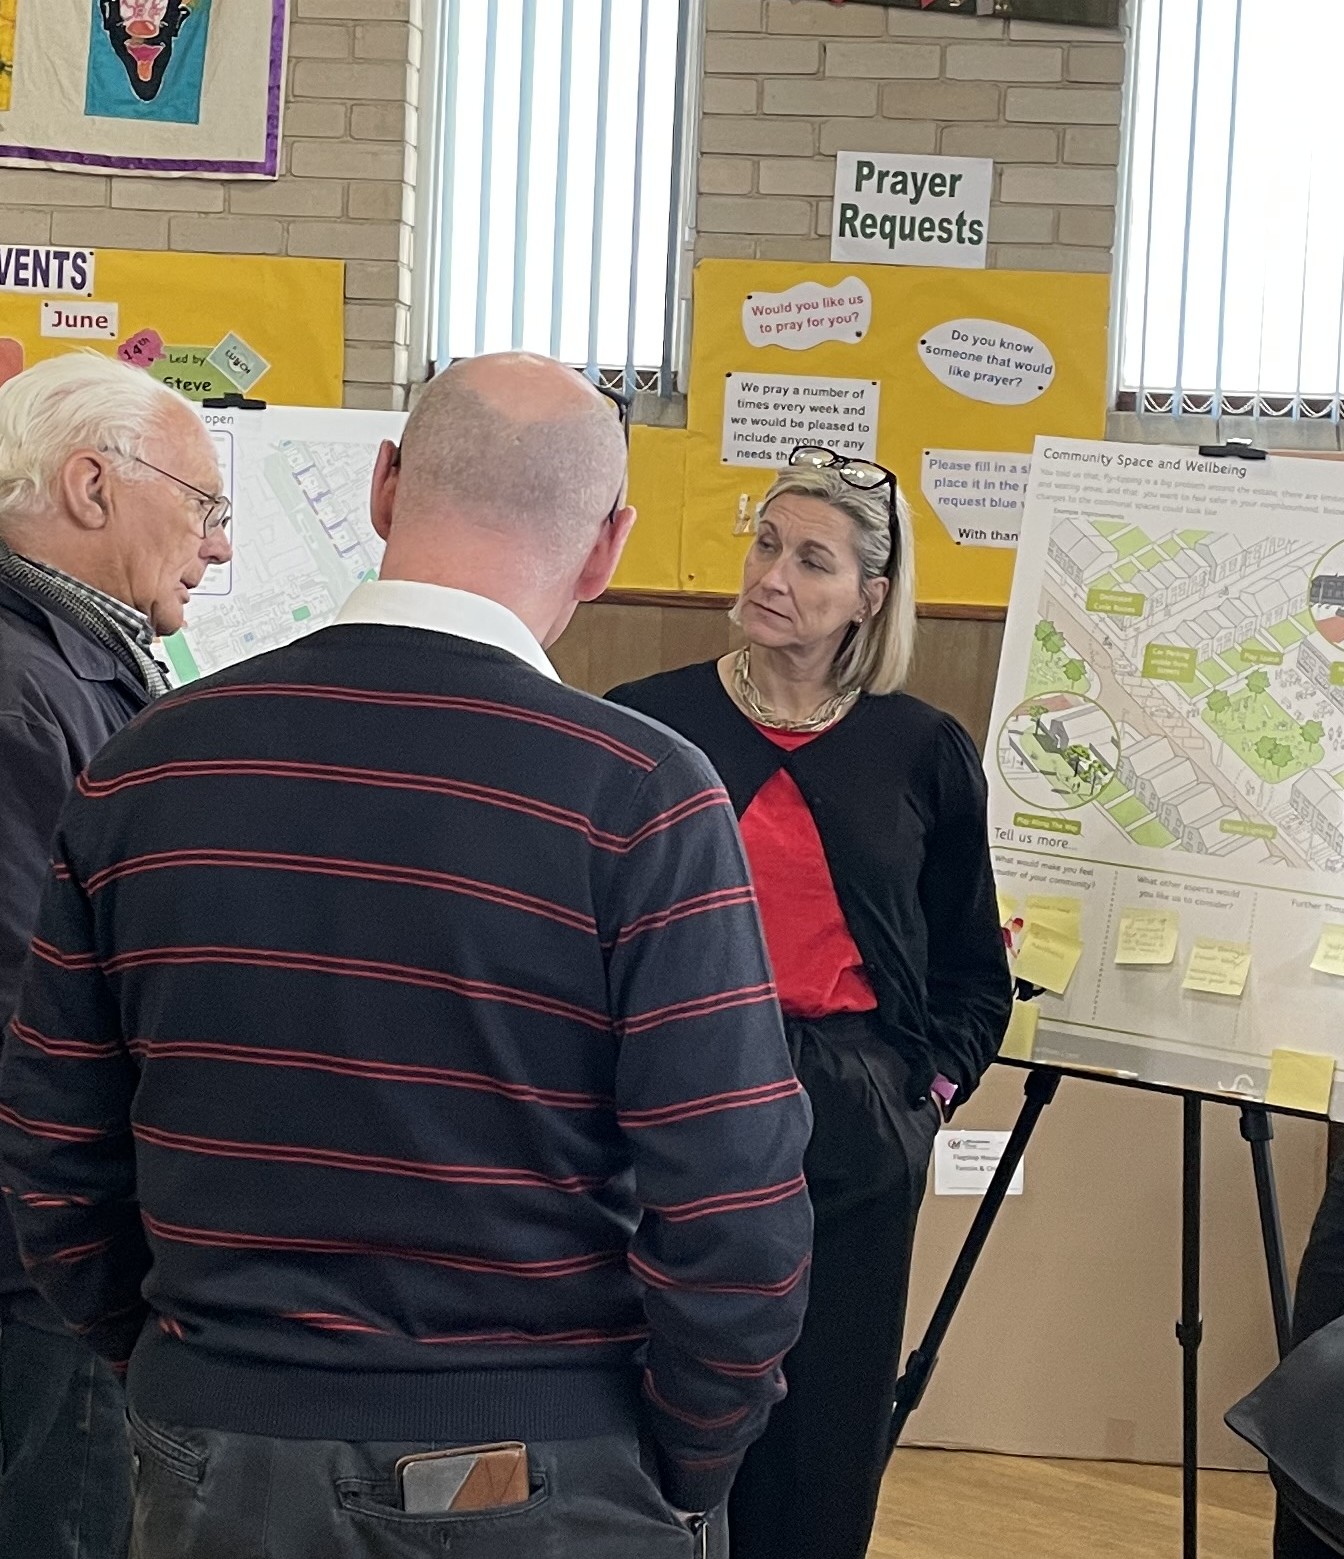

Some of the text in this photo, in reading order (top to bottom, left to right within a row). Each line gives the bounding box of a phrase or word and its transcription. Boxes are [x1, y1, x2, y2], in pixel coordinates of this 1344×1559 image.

[855, 160, 963, 205] Prayer
[839, 203, 983, 249] Requests
[751, 295, 864, 317] Would you like us
[52, 310, 108, 328] June
[760, 311, 860, 334] to pray for you?
[951, 329, 1034, 354] Do you know
[169, 354, 206, 366] Led by
[925, 345, 1053, 375] someone that would
[163, 376, 212, 392] Steve
[948, 365, 1023, 387] like prayer?
[741, 382, 759, 393] We
[762, 384, 790, 397] pray
[802, 387, 850, 399] number
[852, 389, 865, 399] of
[737, 399, 866, 416] times every week and
[730, 416, 870, 433] we would be pleased to
[733, 432, 865, 452] include anyone or any
[736, 449, 772, 460] needs
[1043, 447, 1247, 479] Community Space and Wellbeing
[929, 459, 971, 470] Please
[975, 462, 990, 472] fill
[994, 463, 1006, 473] in
[1009, 465, 1017, 474] a
[934, 477, 1020, 491] place it in the
[938, 496, 1017, 509] request blue
[958, 528, 1019, 542] With than
[995, 827, 1014, 841] Tell
[1019, 834, 1032, 843] us
[995, 854, 1094, 876] What would make you feel
[1139, 890, 1233, 910] you like us to consider?
[1291, 899, 1321, 910] Further
